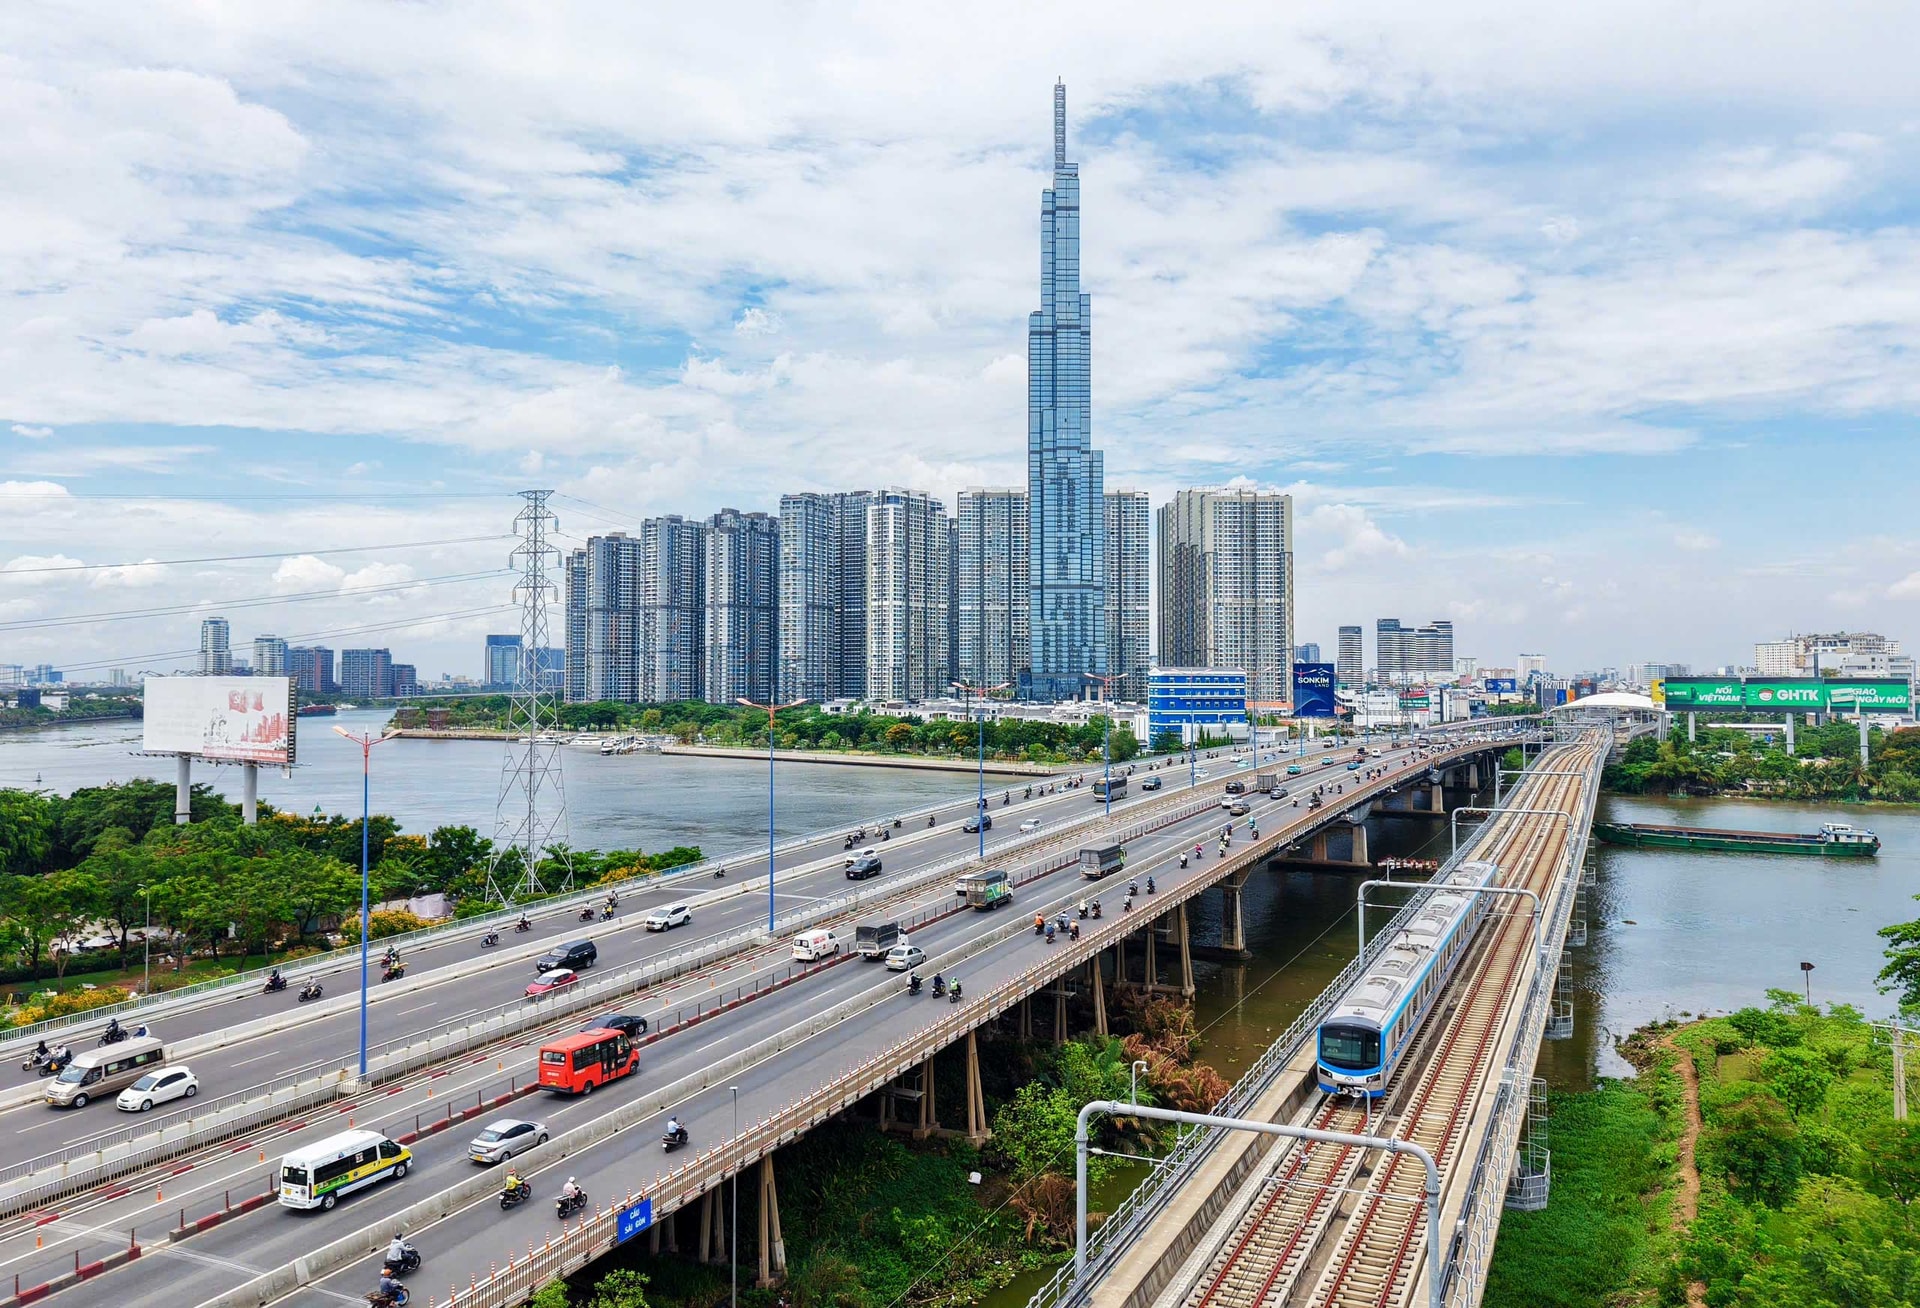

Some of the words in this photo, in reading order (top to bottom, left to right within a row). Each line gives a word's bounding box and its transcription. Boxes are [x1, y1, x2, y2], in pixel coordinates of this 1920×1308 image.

[1715, 684, 1732, 694] NỐI
[1776, 689, 1819, 701] GHTK
[1886, 695, 1907, 704] MỚI
